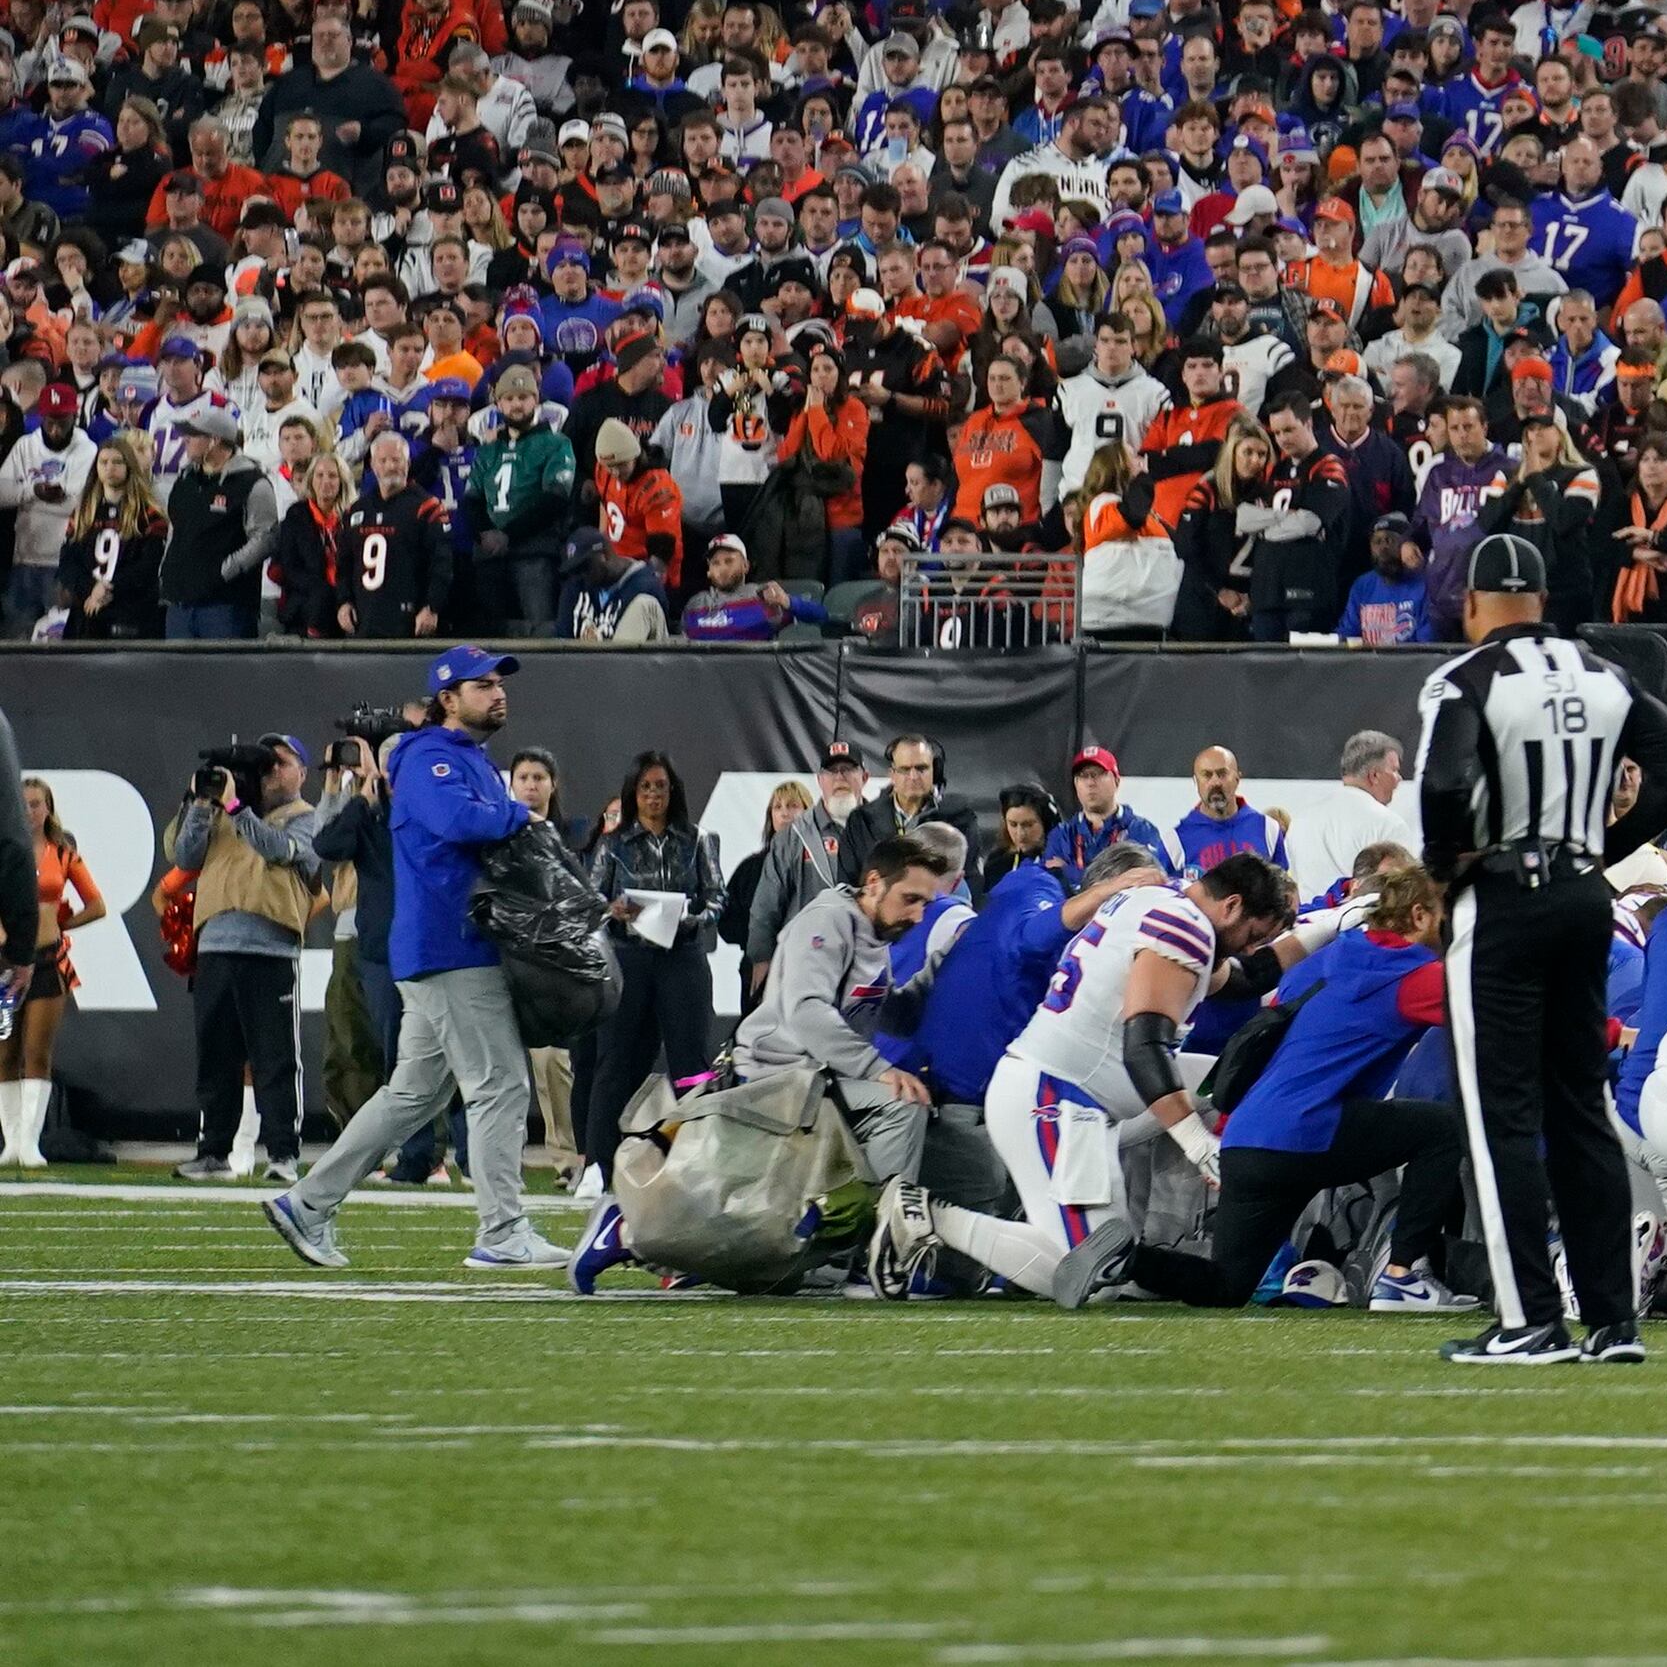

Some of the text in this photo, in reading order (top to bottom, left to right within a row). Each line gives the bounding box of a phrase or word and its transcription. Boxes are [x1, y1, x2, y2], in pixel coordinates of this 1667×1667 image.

[1544, 223, 1588, 272] 17
[152, 429, 187, 474] 17
[493, 464, 513, 512] 1
[95, 529, 118, 583] 9
[362, 532, 387, 591] 9
[1543, 698, 1587, 734] 18
